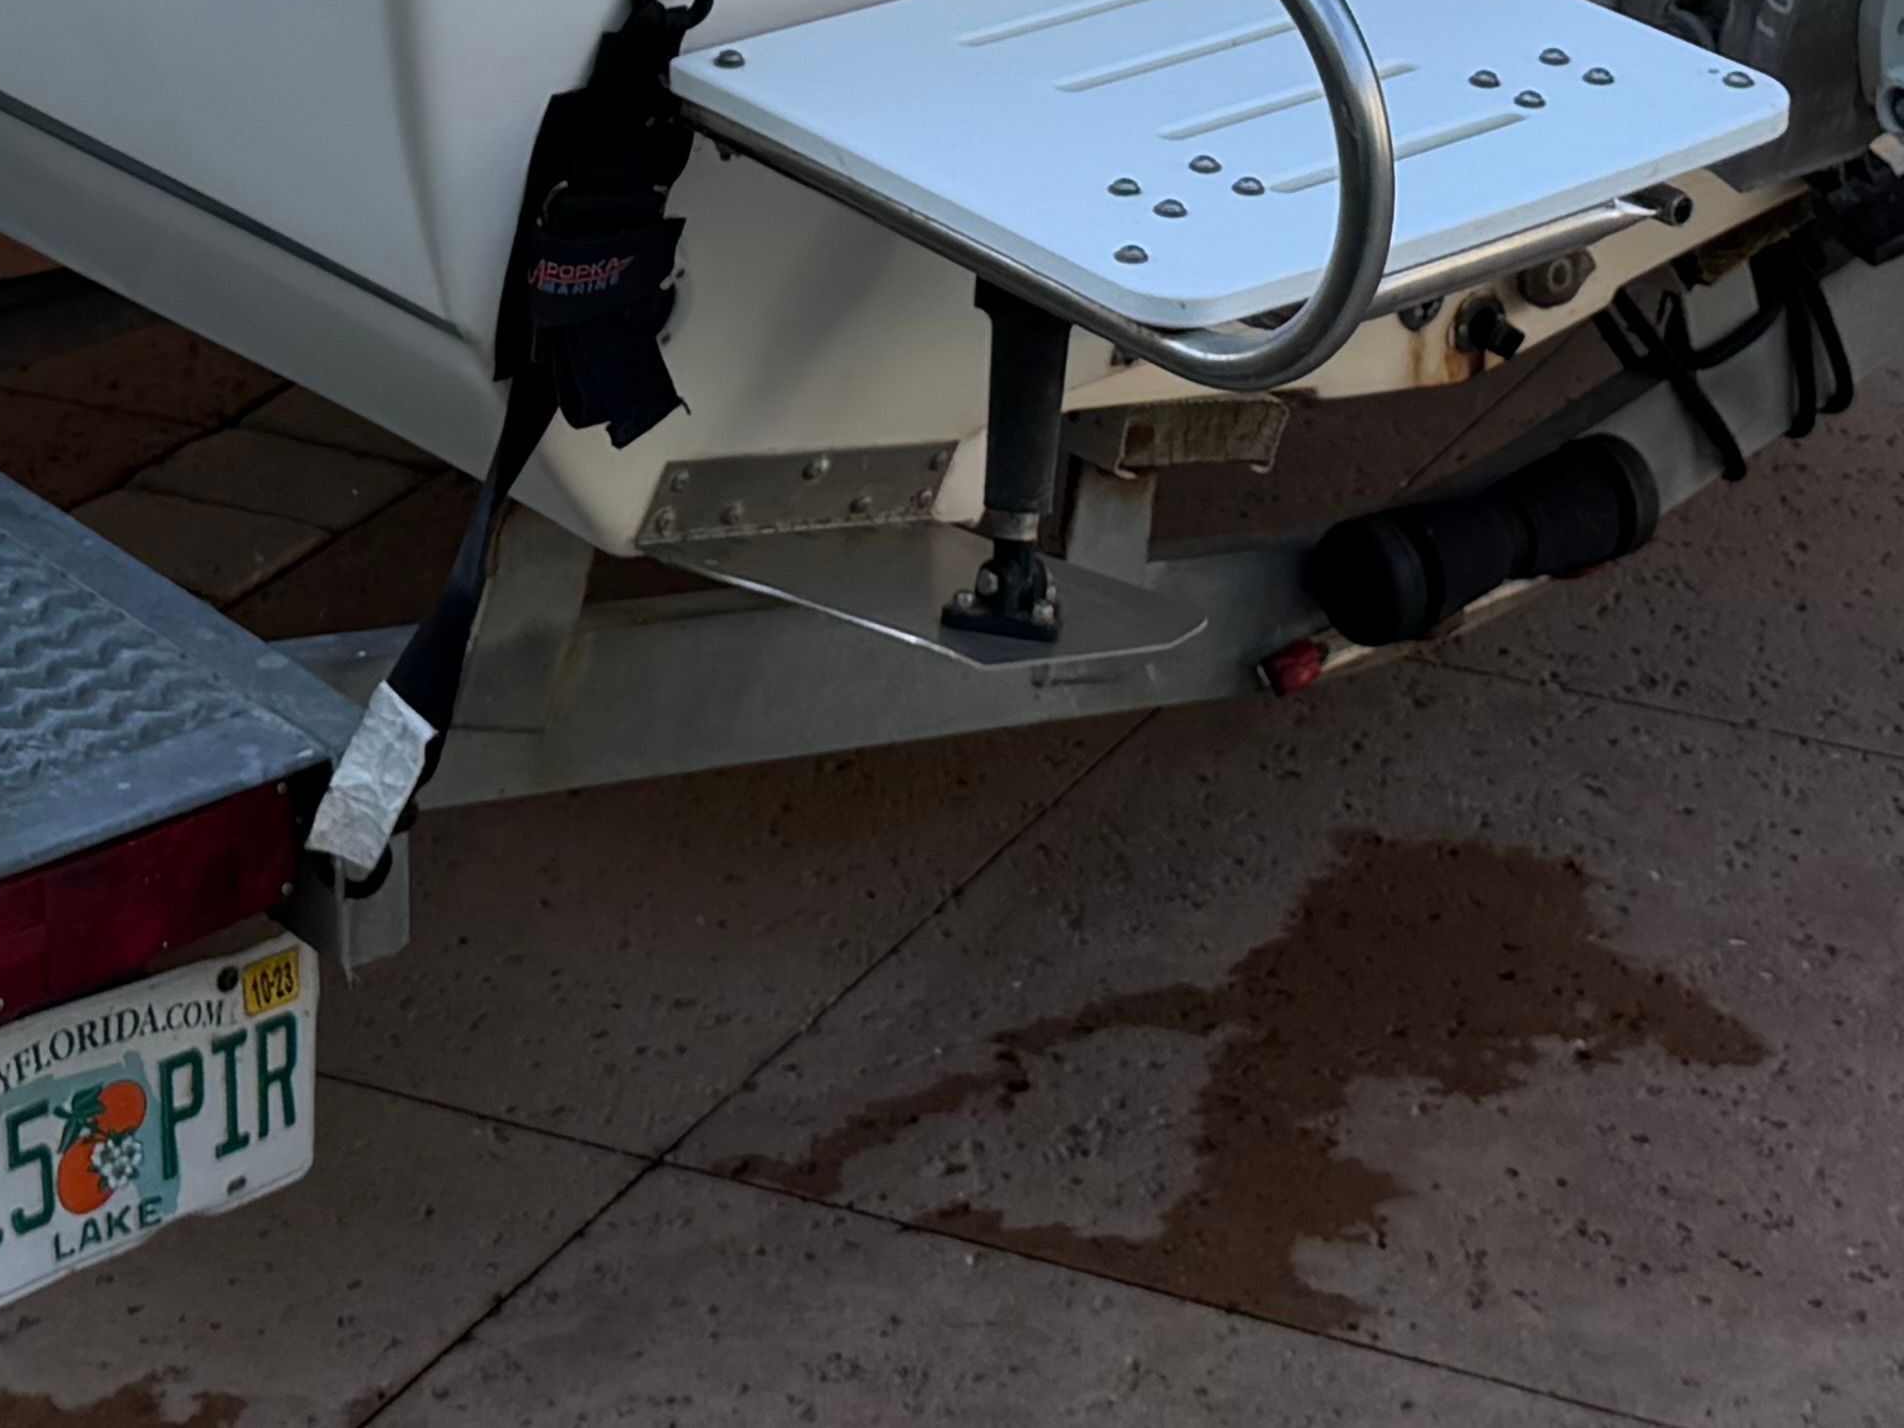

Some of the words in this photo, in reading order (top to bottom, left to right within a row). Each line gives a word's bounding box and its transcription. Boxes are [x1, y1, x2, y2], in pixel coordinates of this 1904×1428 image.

[527, 257, 623, 291] APOPKA
[251, 959, 295, 1008] 10-23
[158, 1010, 299, 1182] PIR
[53, 1196, 164, 1262] LAKE
